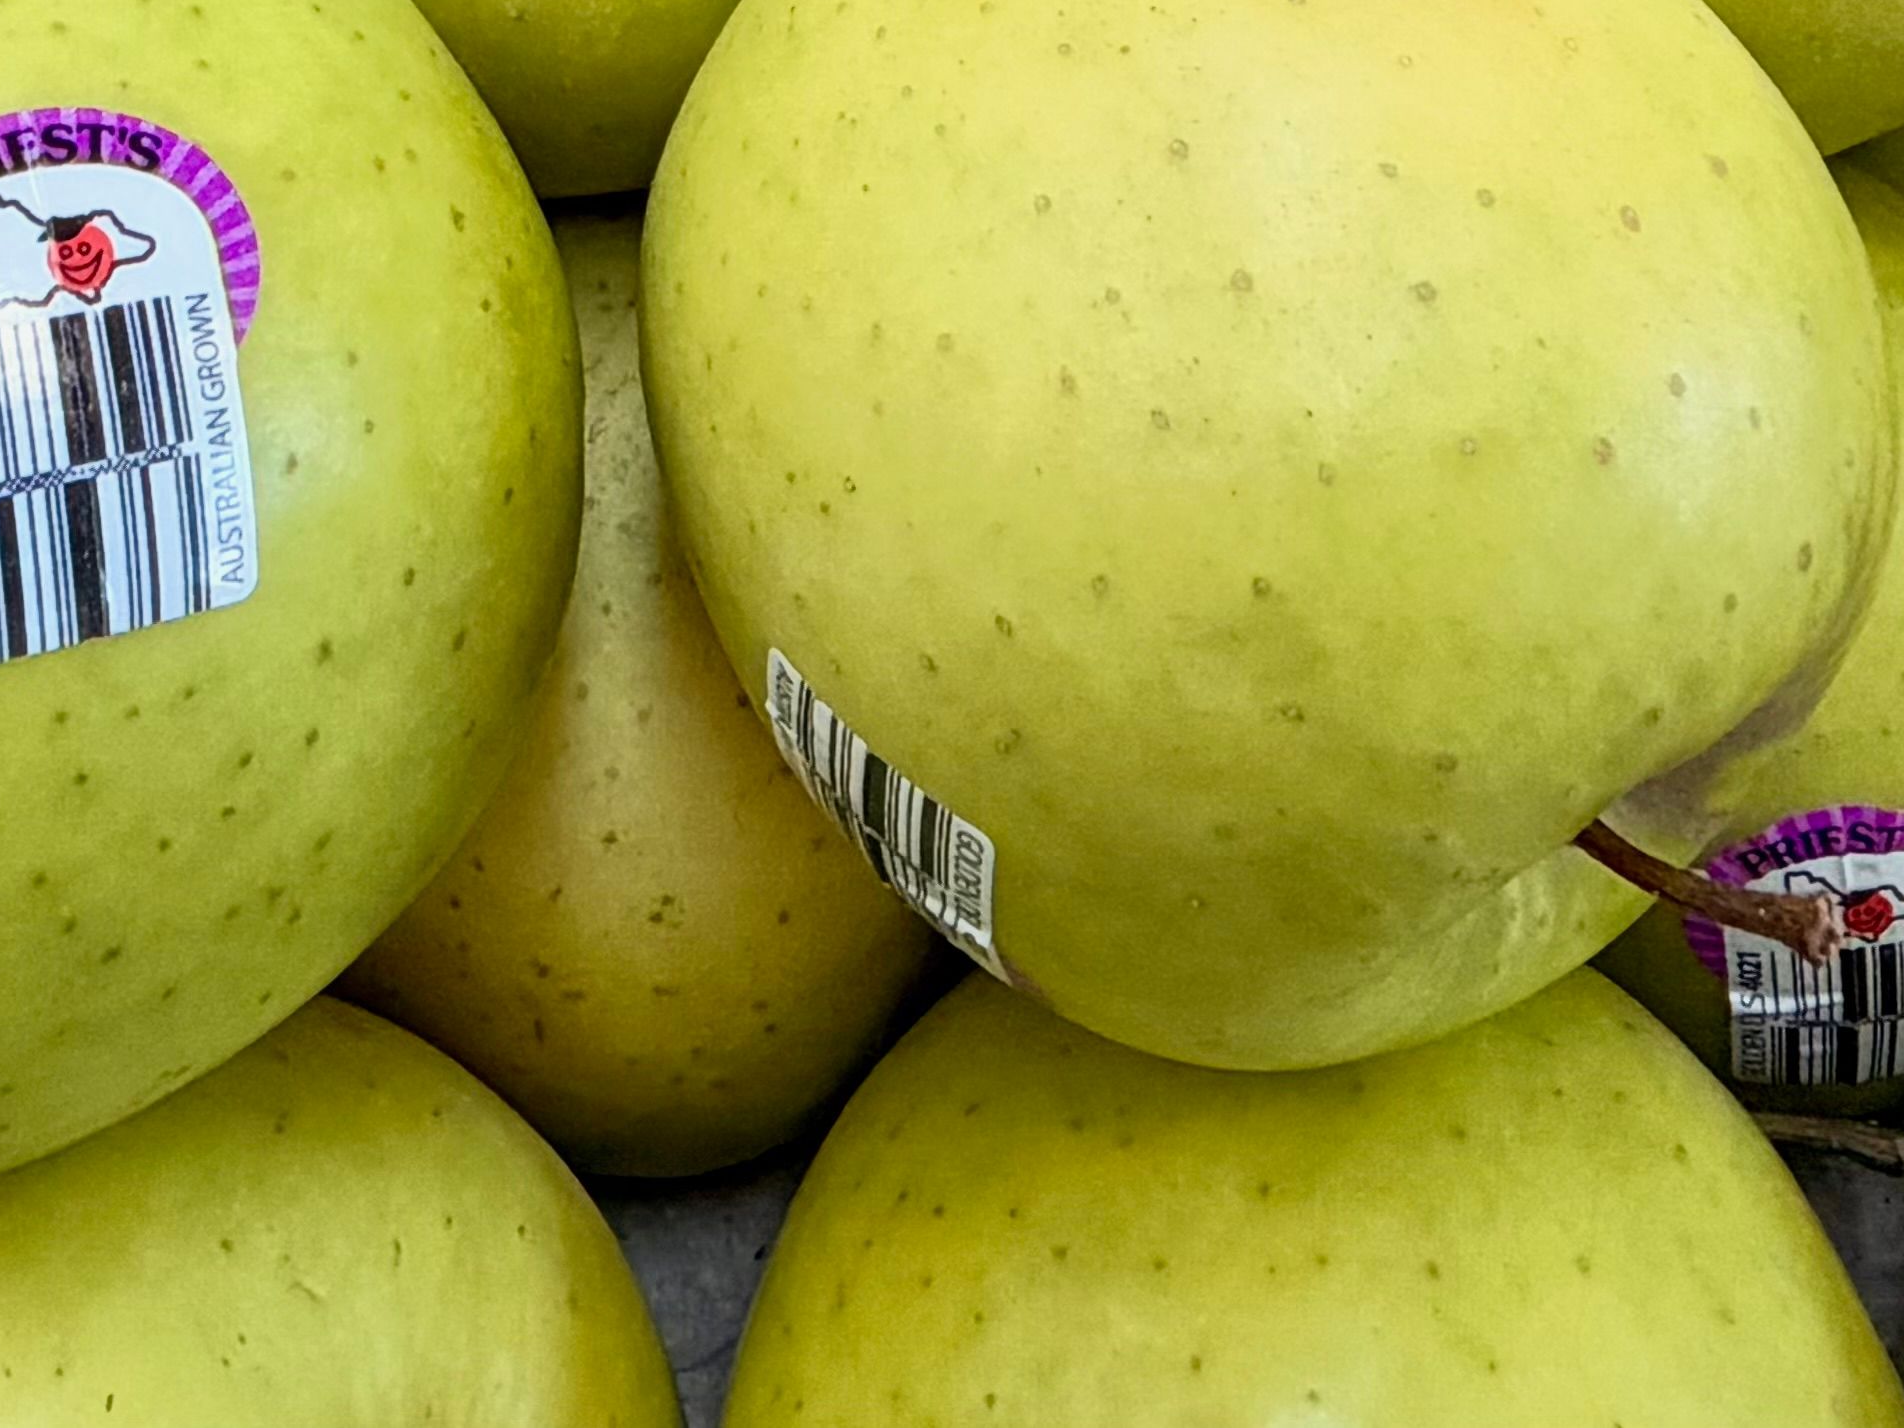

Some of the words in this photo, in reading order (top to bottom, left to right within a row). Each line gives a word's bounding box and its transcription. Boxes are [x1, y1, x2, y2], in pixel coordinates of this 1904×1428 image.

[184, 292, 228, 402] GROWN
[203, 407, 248, 584] AUSTRALIAN
[1735, 950, 1763, 991] 4021
